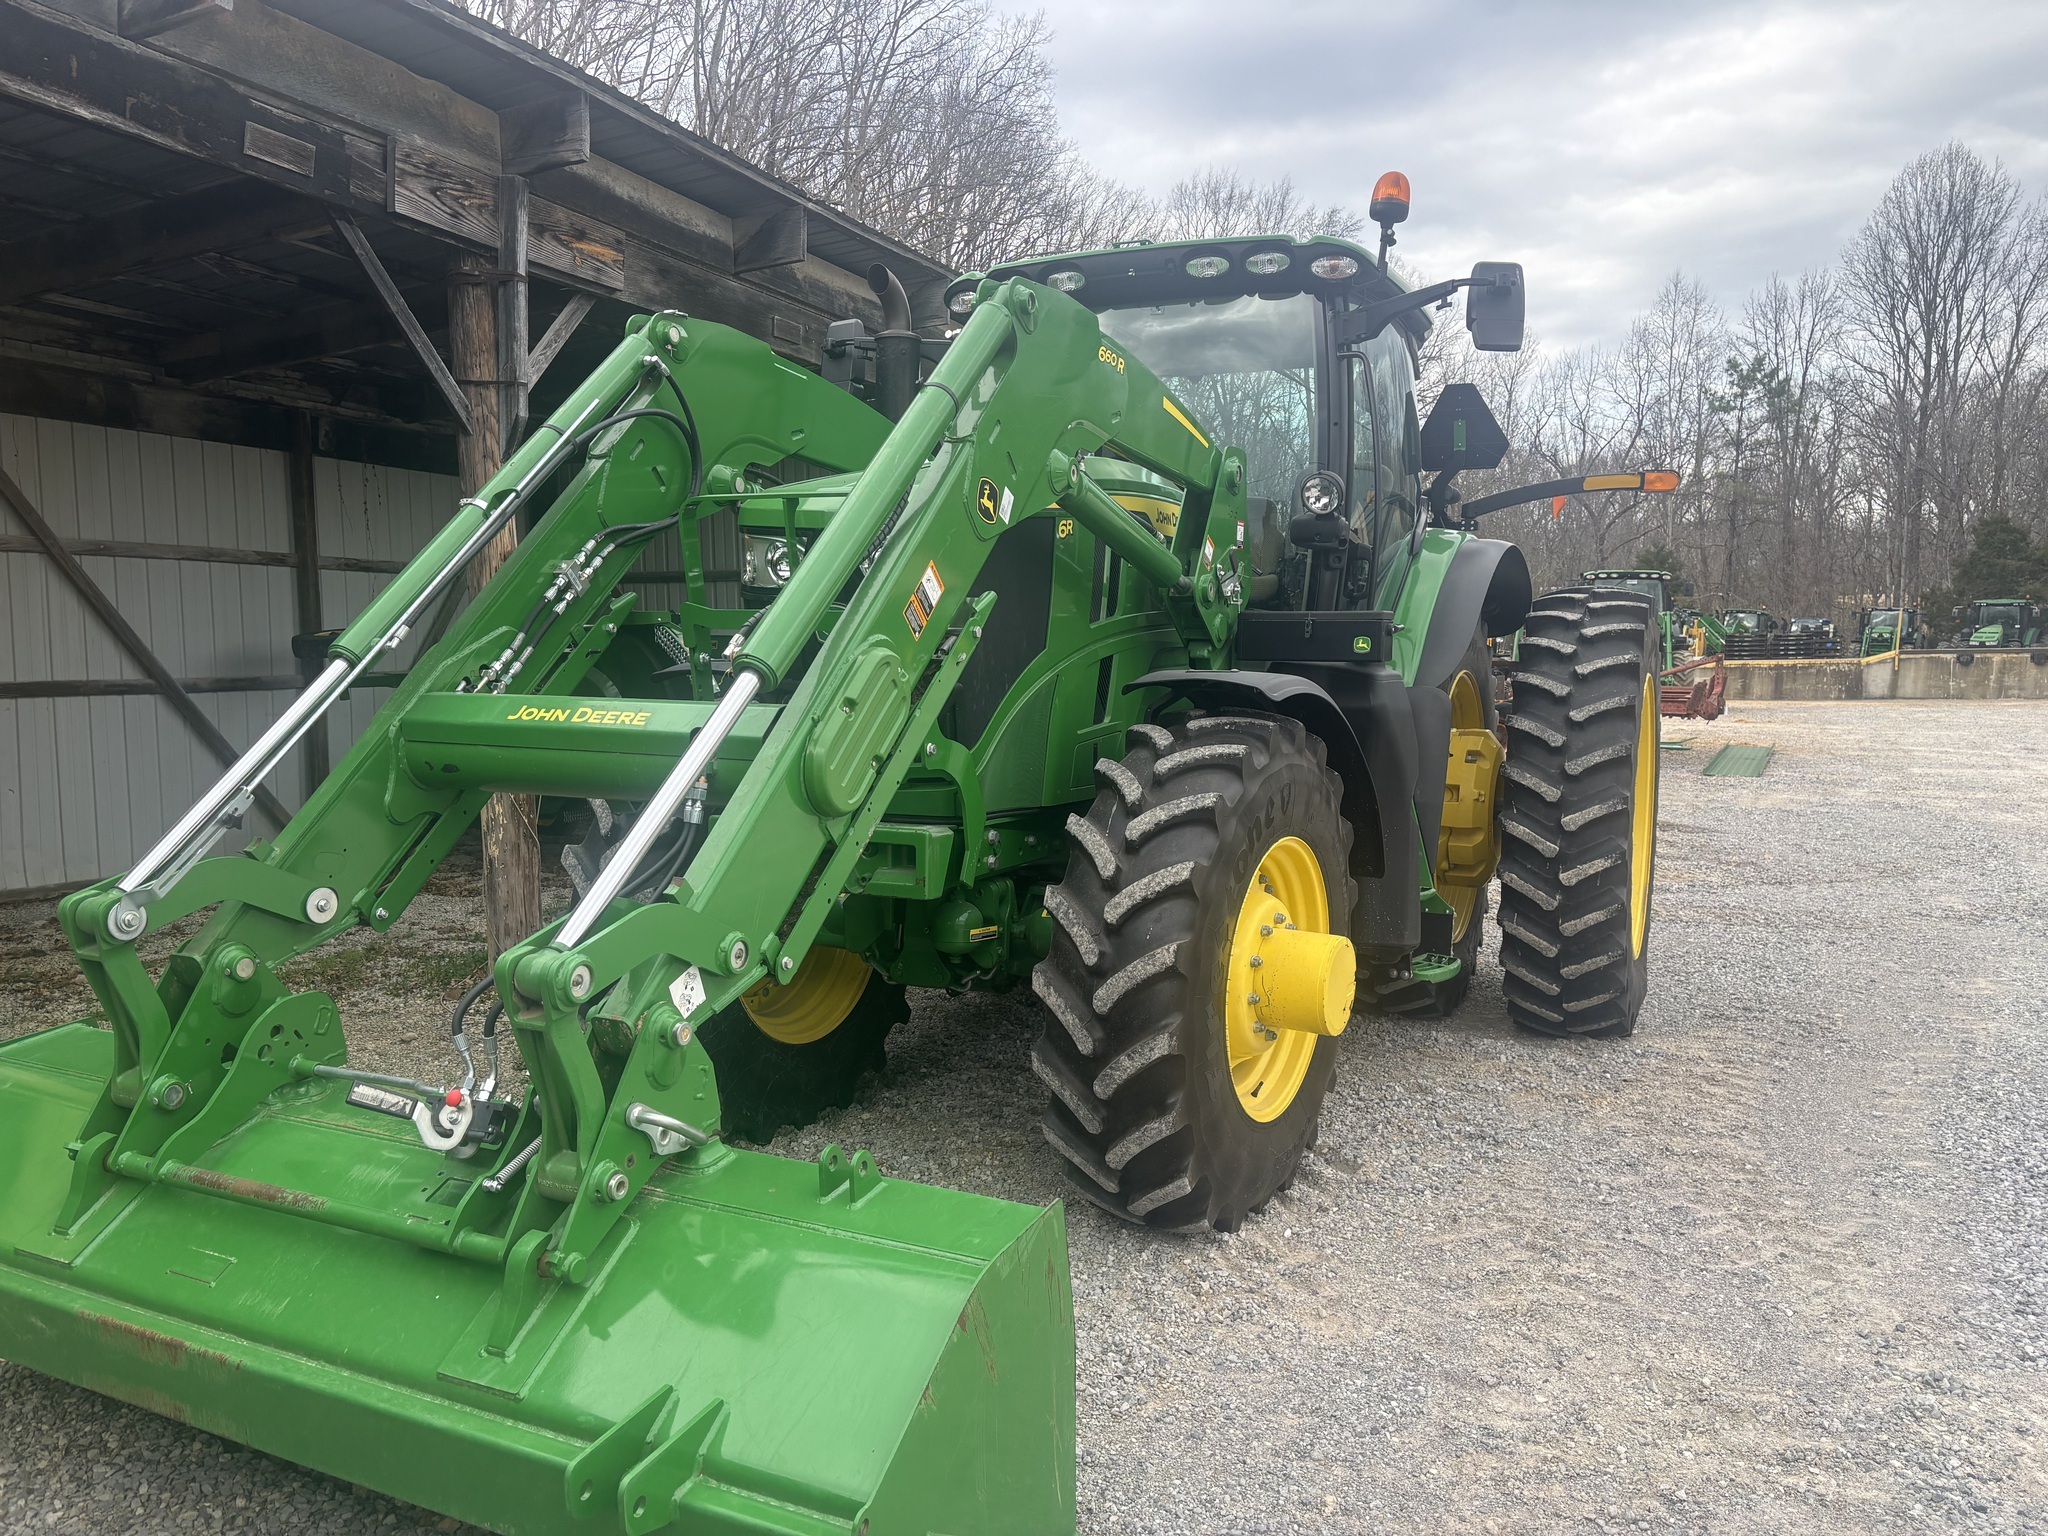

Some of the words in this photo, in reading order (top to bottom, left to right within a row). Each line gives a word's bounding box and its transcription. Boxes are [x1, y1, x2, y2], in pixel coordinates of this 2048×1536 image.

[1155, 507, 1171, 526] JOHN
[1058, 519, 1074, 539] 6R
[506, 705, 571, 723] JOHN
[571, 707, 652, 726] DEERE
